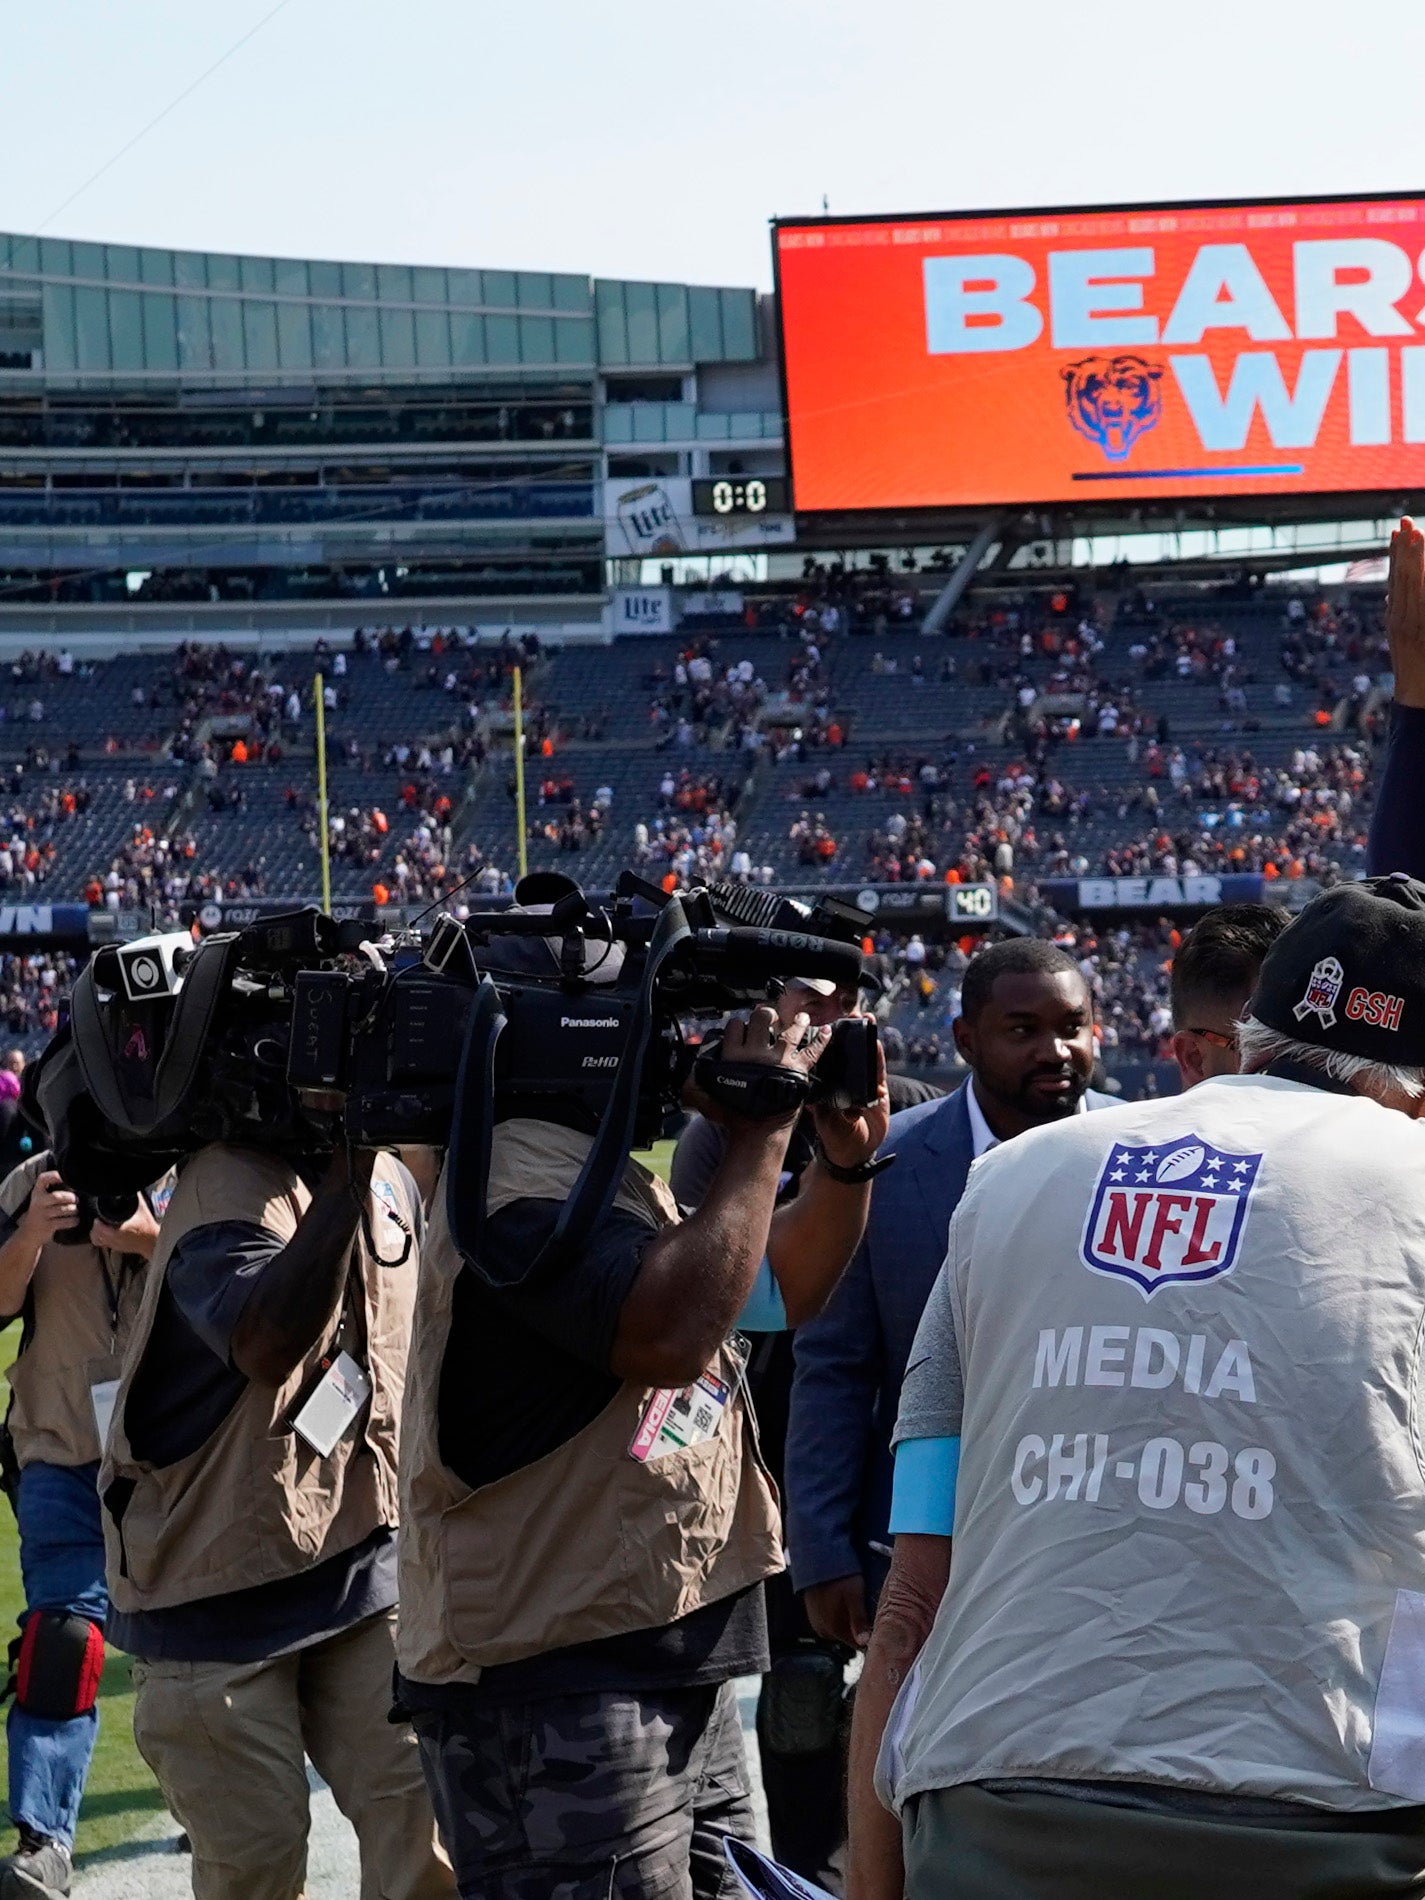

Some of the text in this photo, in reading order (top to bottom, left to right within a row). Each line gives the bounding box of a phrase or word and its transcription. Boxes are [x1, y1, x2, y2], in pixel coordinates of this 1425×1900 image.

[713, 480, 766, 513] 0:0
[630, 502, 671, 538] Lite
[625, 597, 661, 620] Lite
[955, 887, 992, 917] 40
[1077, 876, 1223, 908] BEAR
[1307, 989, 1333, 1007] NFL
[1344, 986, 1405, 1032] GSH
[560, 1016, 620, 1028] Panasonic
[1097, 1192, 1222, 1271] NFL
[1032, 1325, 1257, 1403] MEDIA
[1010, 1434, 1277, 1520] CHI-038
